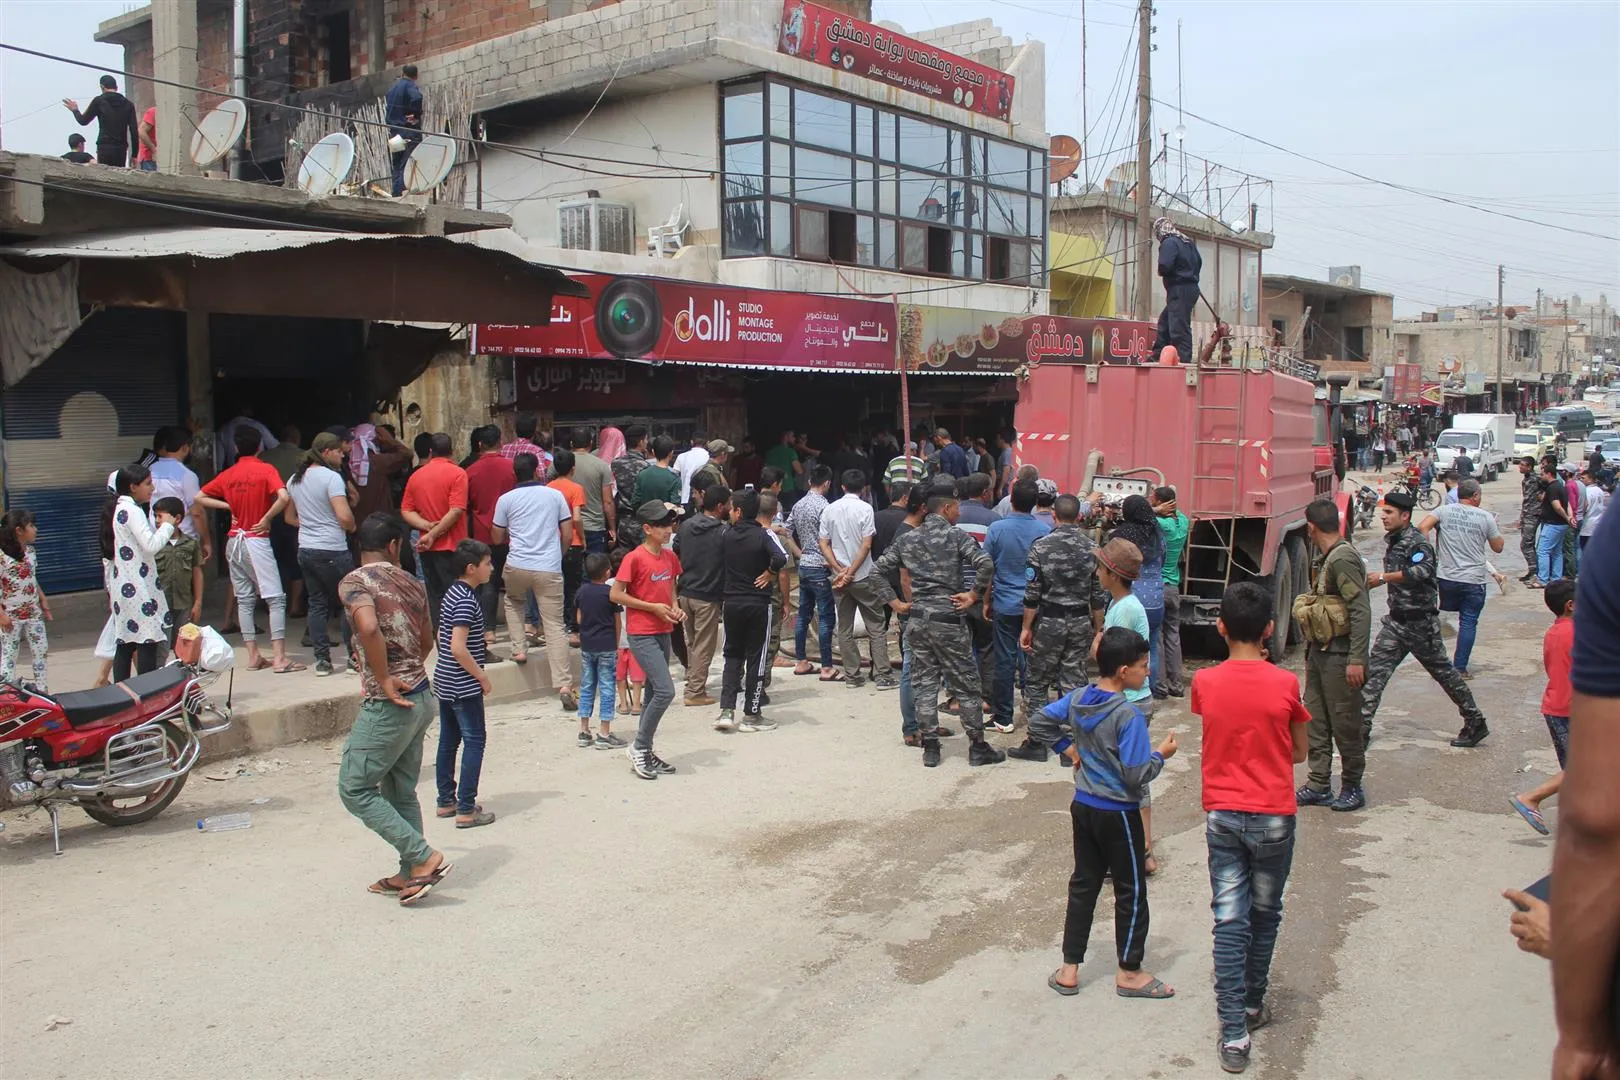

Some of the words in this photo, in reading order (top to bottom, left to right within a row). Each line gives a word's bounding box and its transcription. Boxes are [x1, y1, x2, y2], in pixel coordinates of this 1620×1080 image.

[826, 18, 870, 47] دمشق
[874, 32, 904, 63] بوابة
[887, 70, 903, 82] ساخنة
[907, 76, 920, 89] باردة
[953, 65, 984, 87] مجمع
[920, 81, 942, 95] مشروبات
[738, 302, 763, 314] STUDIO
[674, 297, 731, 342] dalli
[738, 316, 774, 329] MONTAGE
[804, 311, 822, 321] تصوير
[822, 312, 840, 321] لخدمة
[860, 320, 876, 329] مجمع
[738, 331, 783, 344] PRODUCTION
[842, 323, 888, 348] دلي
[1026, 319, 1084, 363] دمشق
[752, 680, 763, 713] adidas
